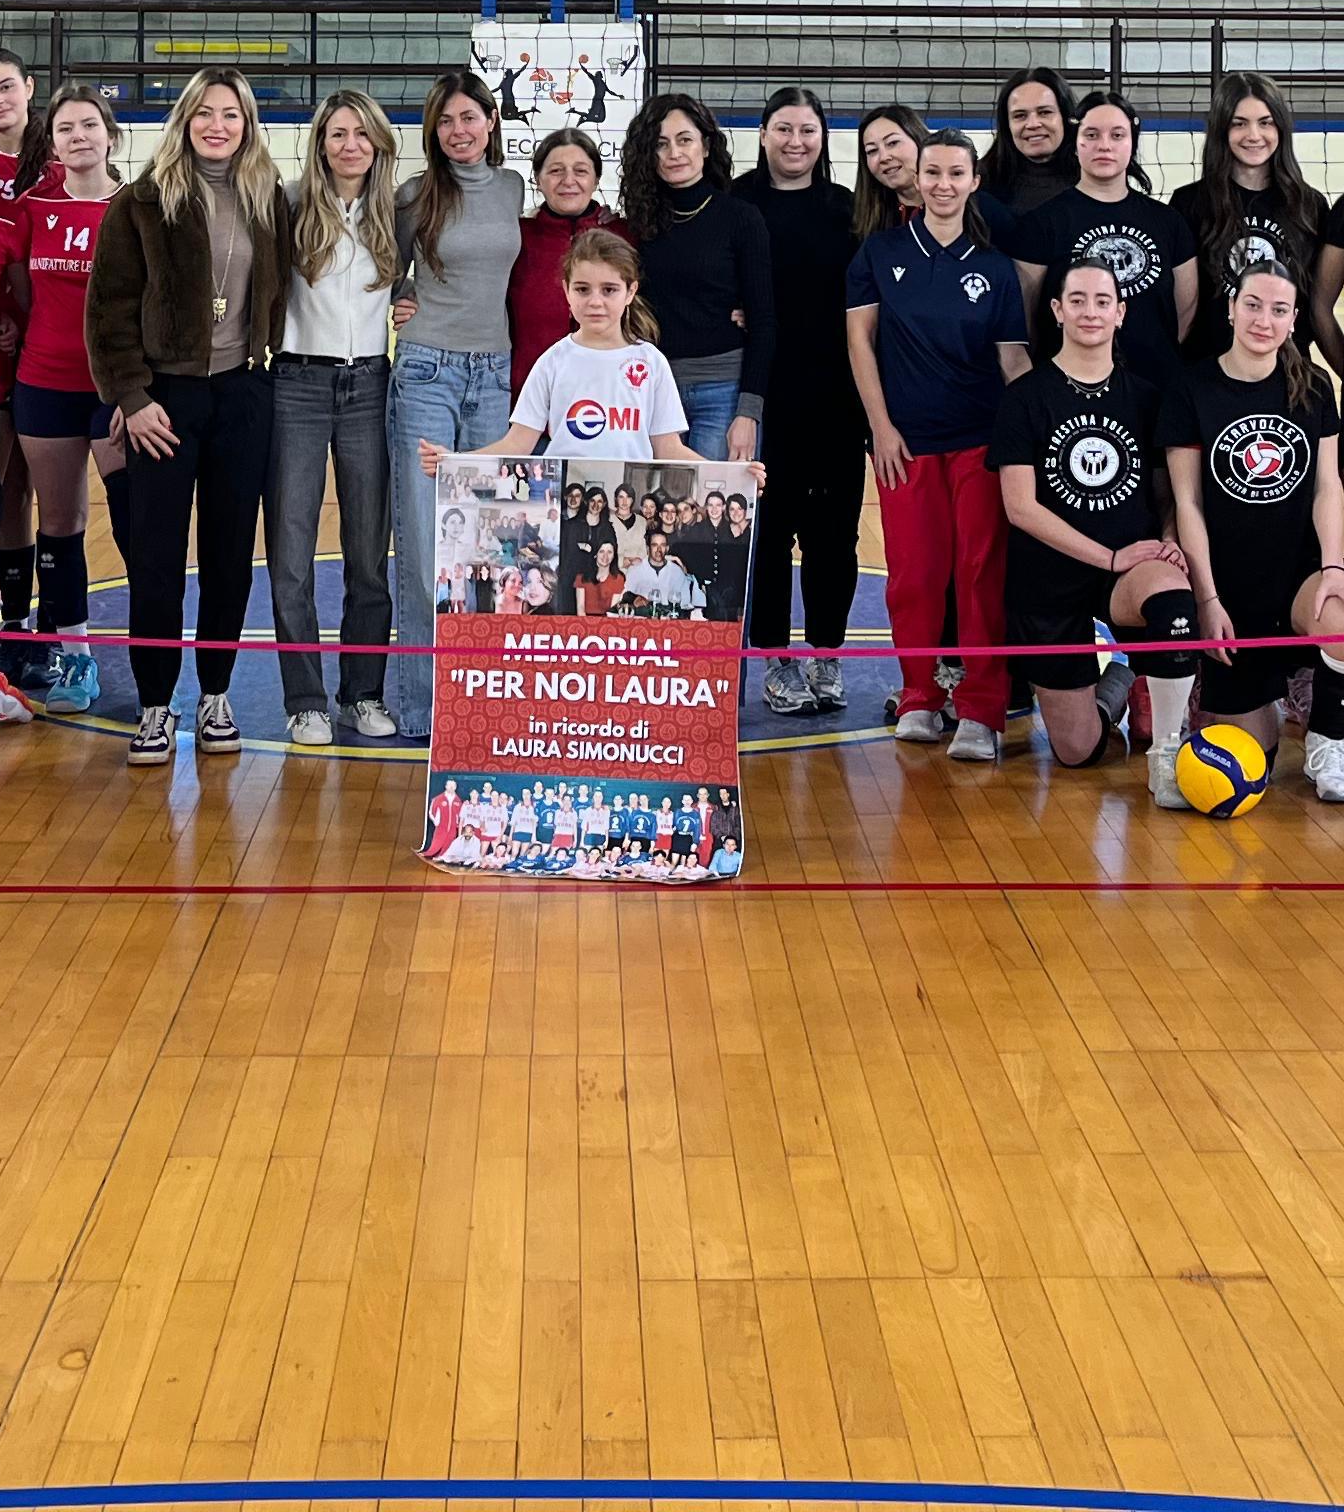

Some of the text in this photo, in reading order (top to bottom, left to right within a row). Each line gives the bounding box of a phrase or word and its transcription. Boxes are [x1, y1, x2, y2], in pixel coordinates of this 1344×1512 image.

[63, 226, 90, 252] 14
[1048, 414, 1138, 452] TRESTINA VOLLEY
[1218, 418, 1303, 452] STARVOLLEY
[1044, 457, 1056, 468] 20
[1132, 457, 1141, 469] 21
[1046, 472, 1141, 511] TRESTINA VOLLEY
[502, 633, 680, 668] MEMORIAL
[450, 669, 729, 708] "PER NOI LAURA"
[528, 715, 649, 739] in ricordo di
[492, 737, 685, 765] LAURA SIMONUCCI
[1199, 747, 1232, 769] MIKASA
